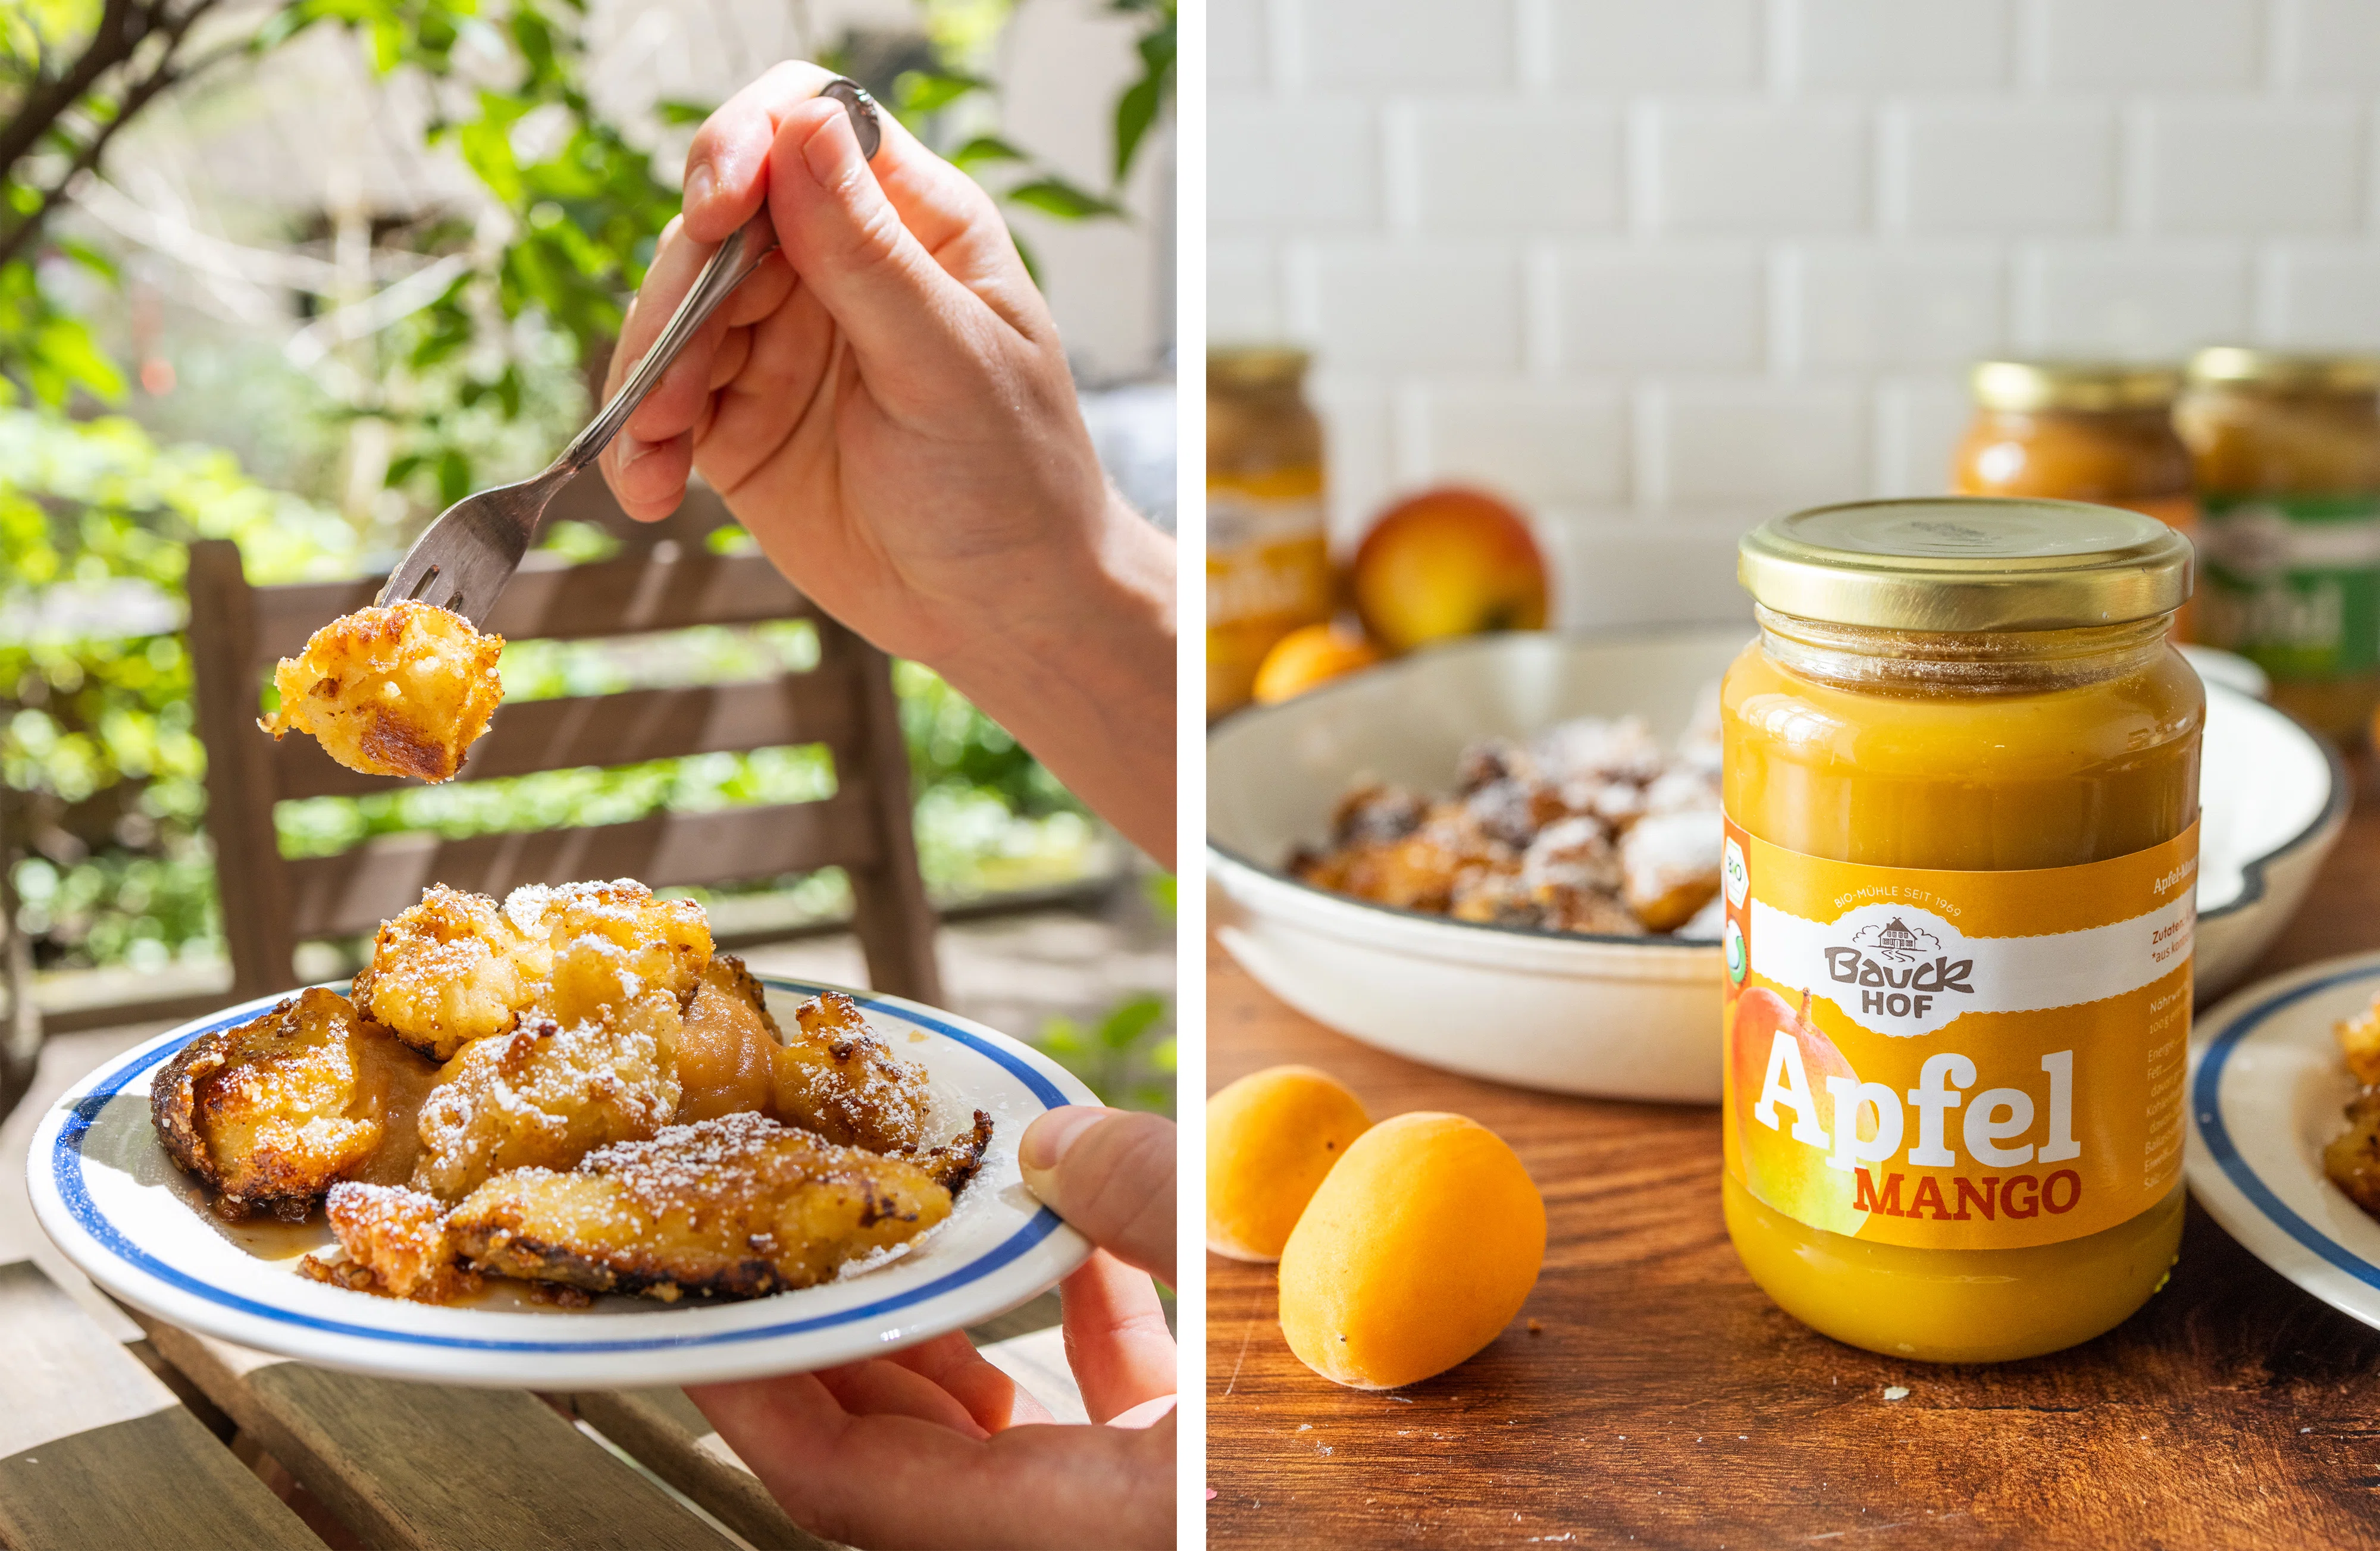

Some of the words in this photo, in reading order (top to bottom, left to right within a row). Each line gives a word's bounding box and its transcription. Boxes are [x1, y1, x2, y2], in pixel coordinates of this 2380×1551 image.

[1834, 885, 1899, 908] BIO-MÜHLE
[1904, 888, 1932, 901] SEIT
[1936, 897, 1962, 917] 1969
[1824, 947, 1975, 994] Bauck
[1862, 989, 1933, 1019] HOF
[1755, 1029, 2081, 1172] Apfel
[1853, 1167, 2081, 1221] MANGO
